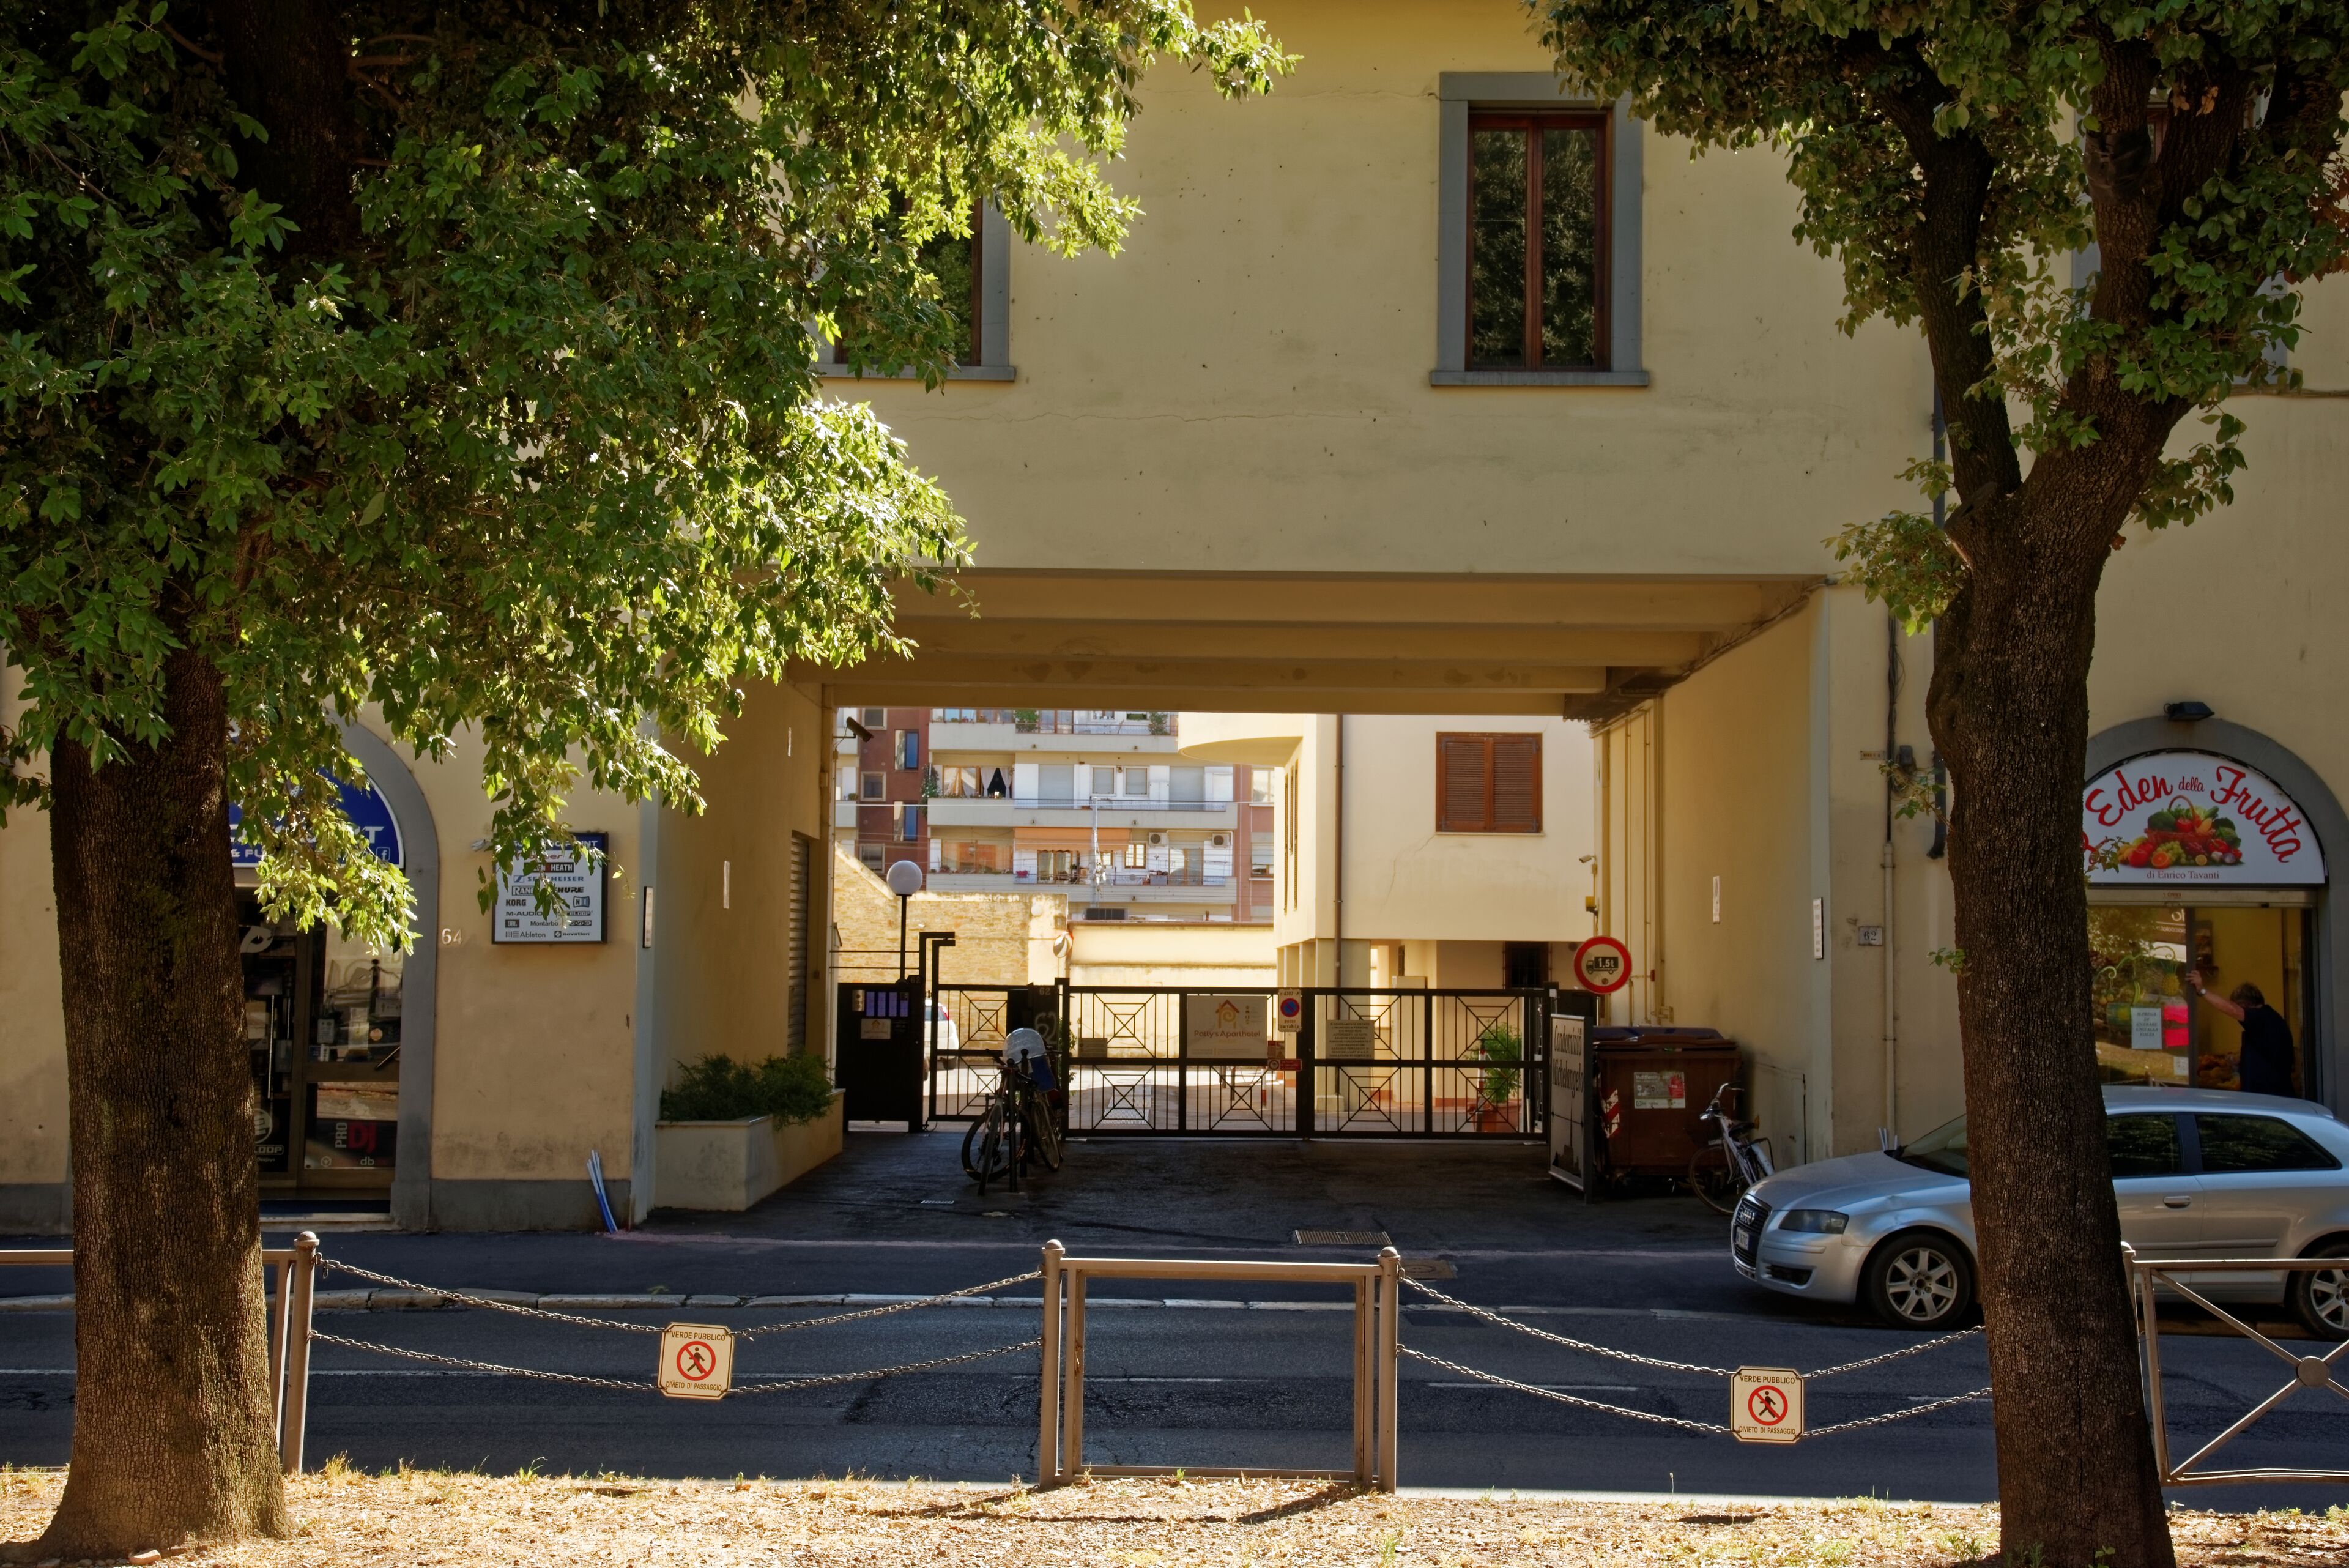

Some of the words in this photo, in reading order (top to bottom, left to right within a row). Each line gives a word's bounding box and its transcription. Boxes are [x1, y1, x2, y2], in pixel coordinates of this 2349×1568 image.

[2085, 770, 2173, 827] Eden
[2178, 776, 2205, 792] della
[2210, 765, 2301, 863] Frutta
[2147, 870, 2155, 879] di
[2158, 871, 2184, 879] Enrico
[2188, 871, 2220, 879] Tavanti
[442, 928, 462, 945] 64
[1863, 931, 1877, 941] 62
[1039, 987, 1051, 995] 62
[1220, 1030, 1261, 1038] Aparthotel
[1554, 1025, 1582, 1056] Condominio
[1553, 1058, 1584, 1099] Michelangelo
[335, 1122, 348, 1148] PRO
[347, 1121, 377, 1154] DJ
[360, 1156, 375, 1166] db
[694, 1332, 726, 1342] PUBBLICO
